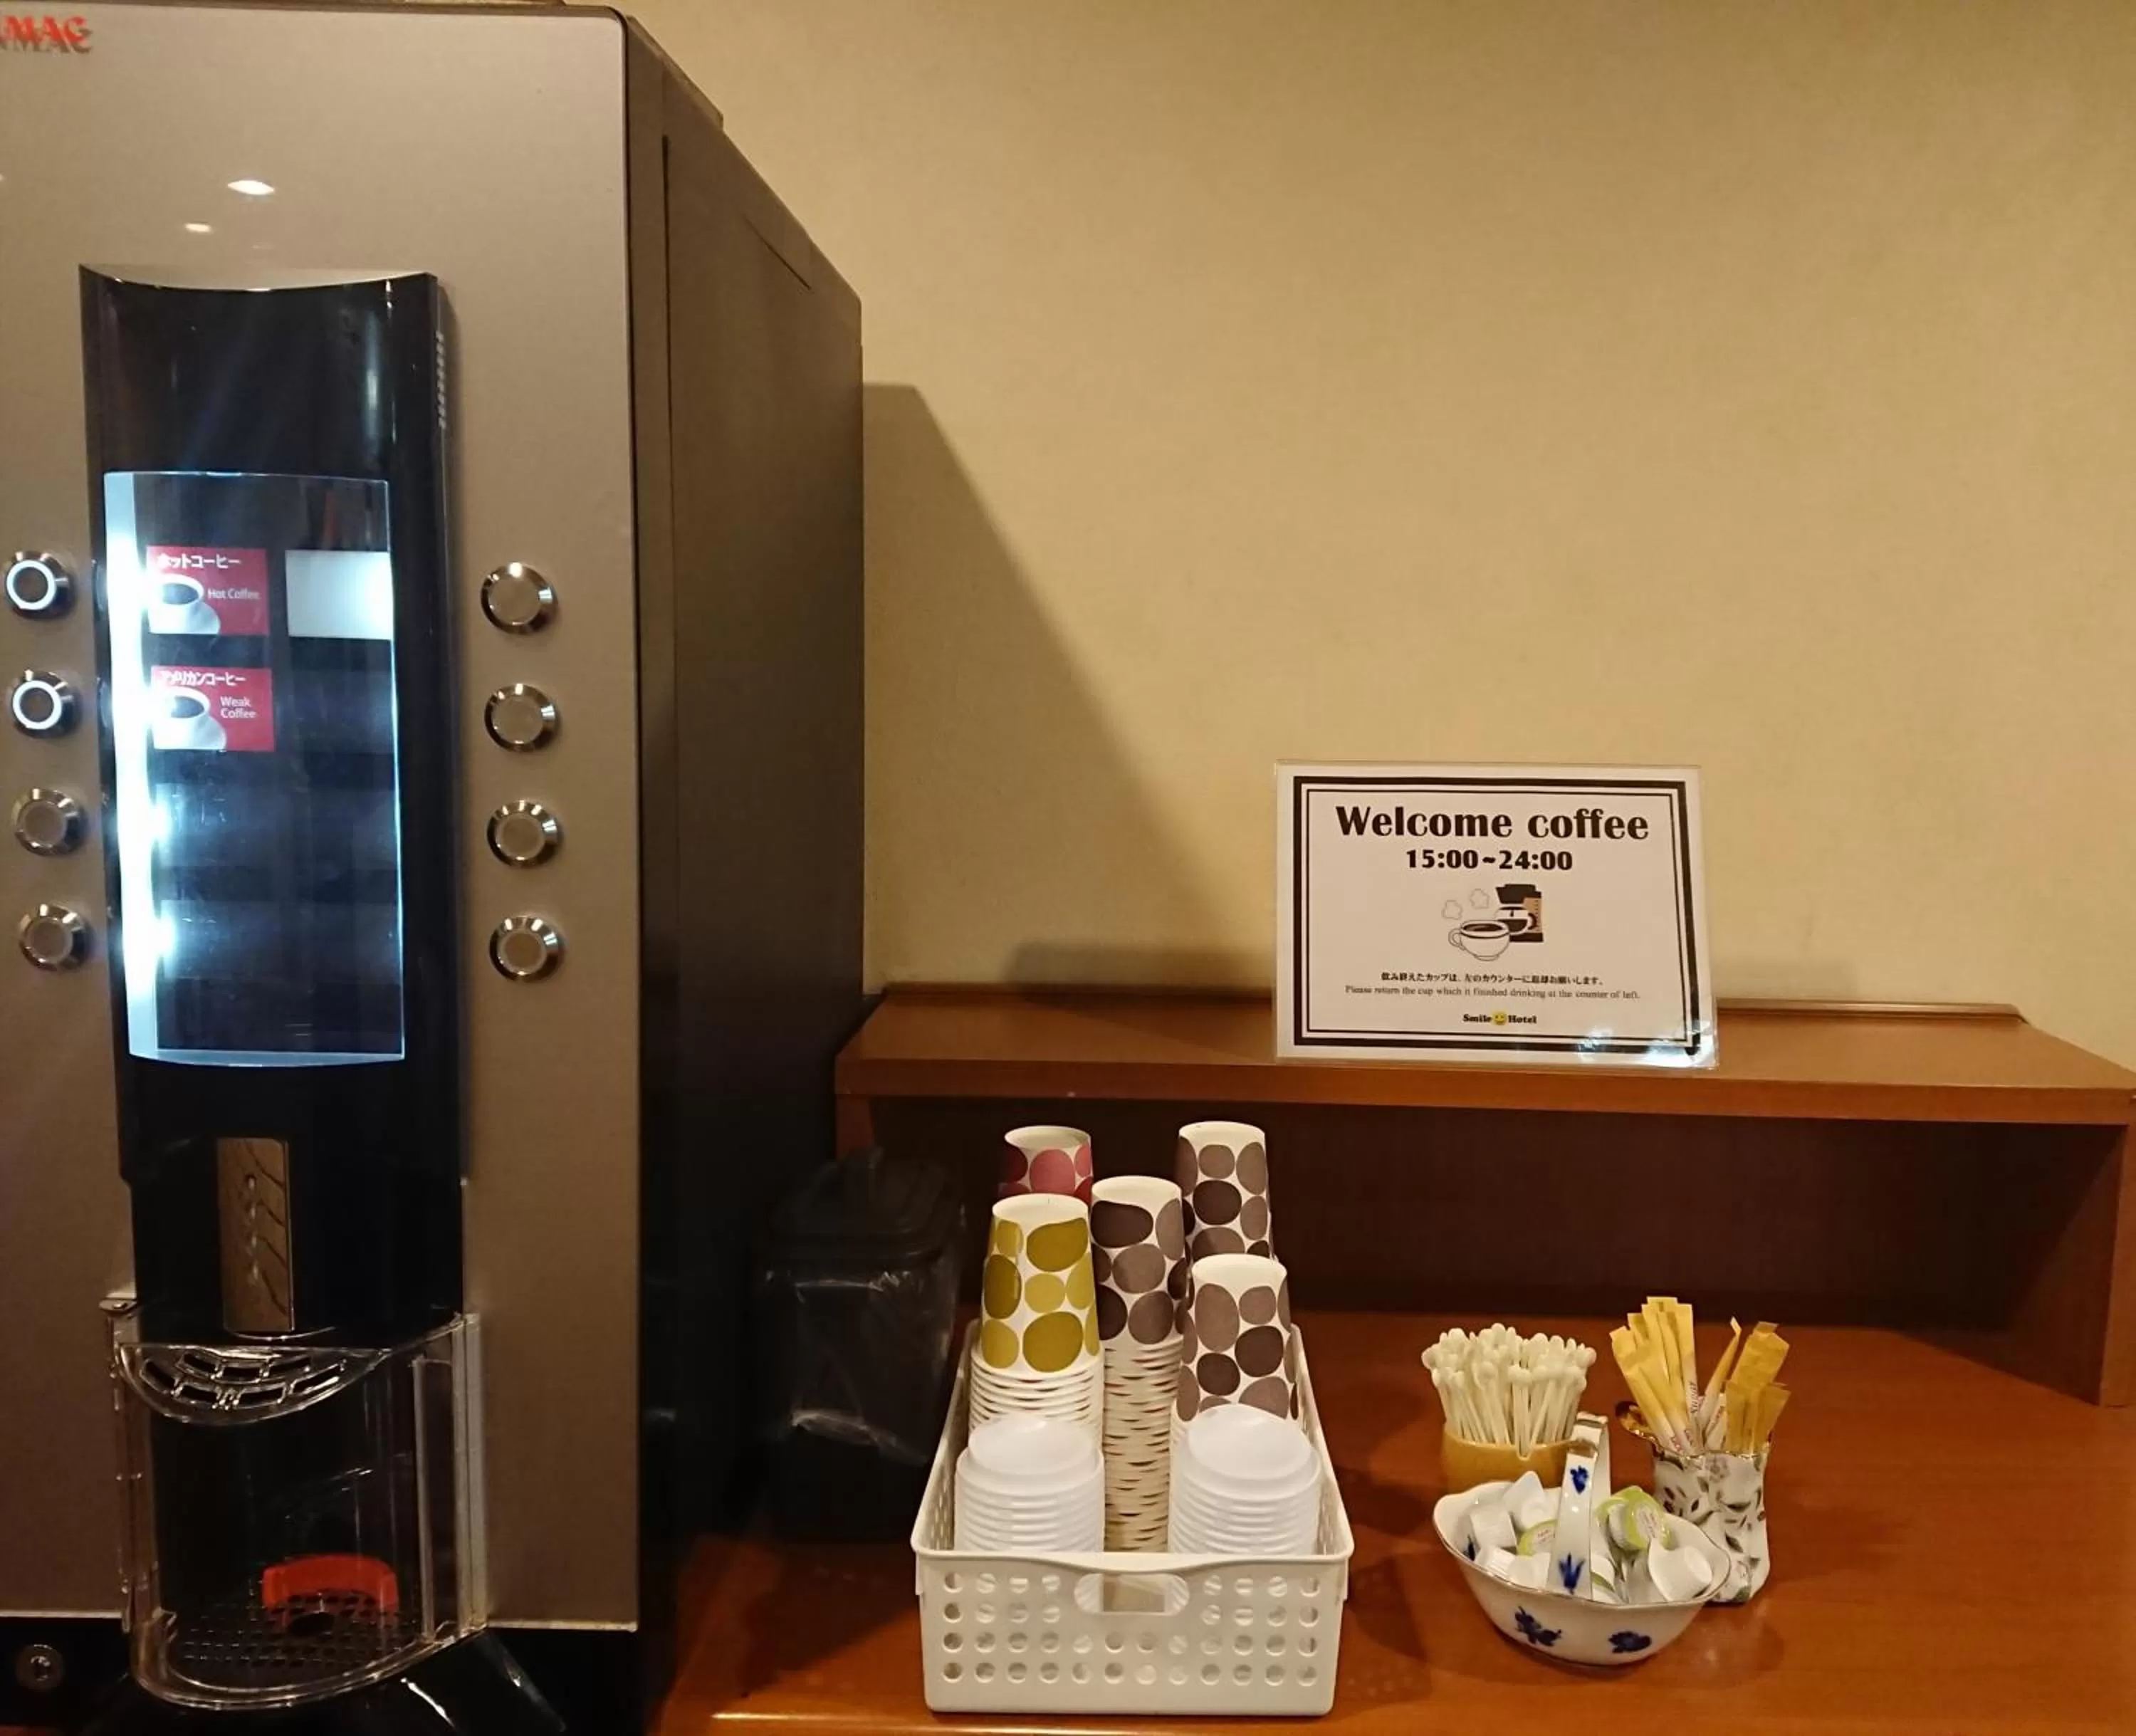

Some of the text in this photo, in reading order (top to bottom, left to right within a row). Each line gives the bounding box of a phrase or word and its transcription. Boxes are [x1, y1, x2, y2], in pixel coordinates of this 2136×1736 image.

[207, 588, 261, 600] Hot Coffee
[220, 696, 251, 707] Weak
[220, 708, 256, 718] Coffee
[1335, 806, 1650, 840] Welcome coffee
[1345, 985, 1372, 994] Please
[1510, 988, 1545, 998] drinking
[1610, 990, 1621, 998] of
[1462, 1014, 1537, 1024] Smile Hotel
